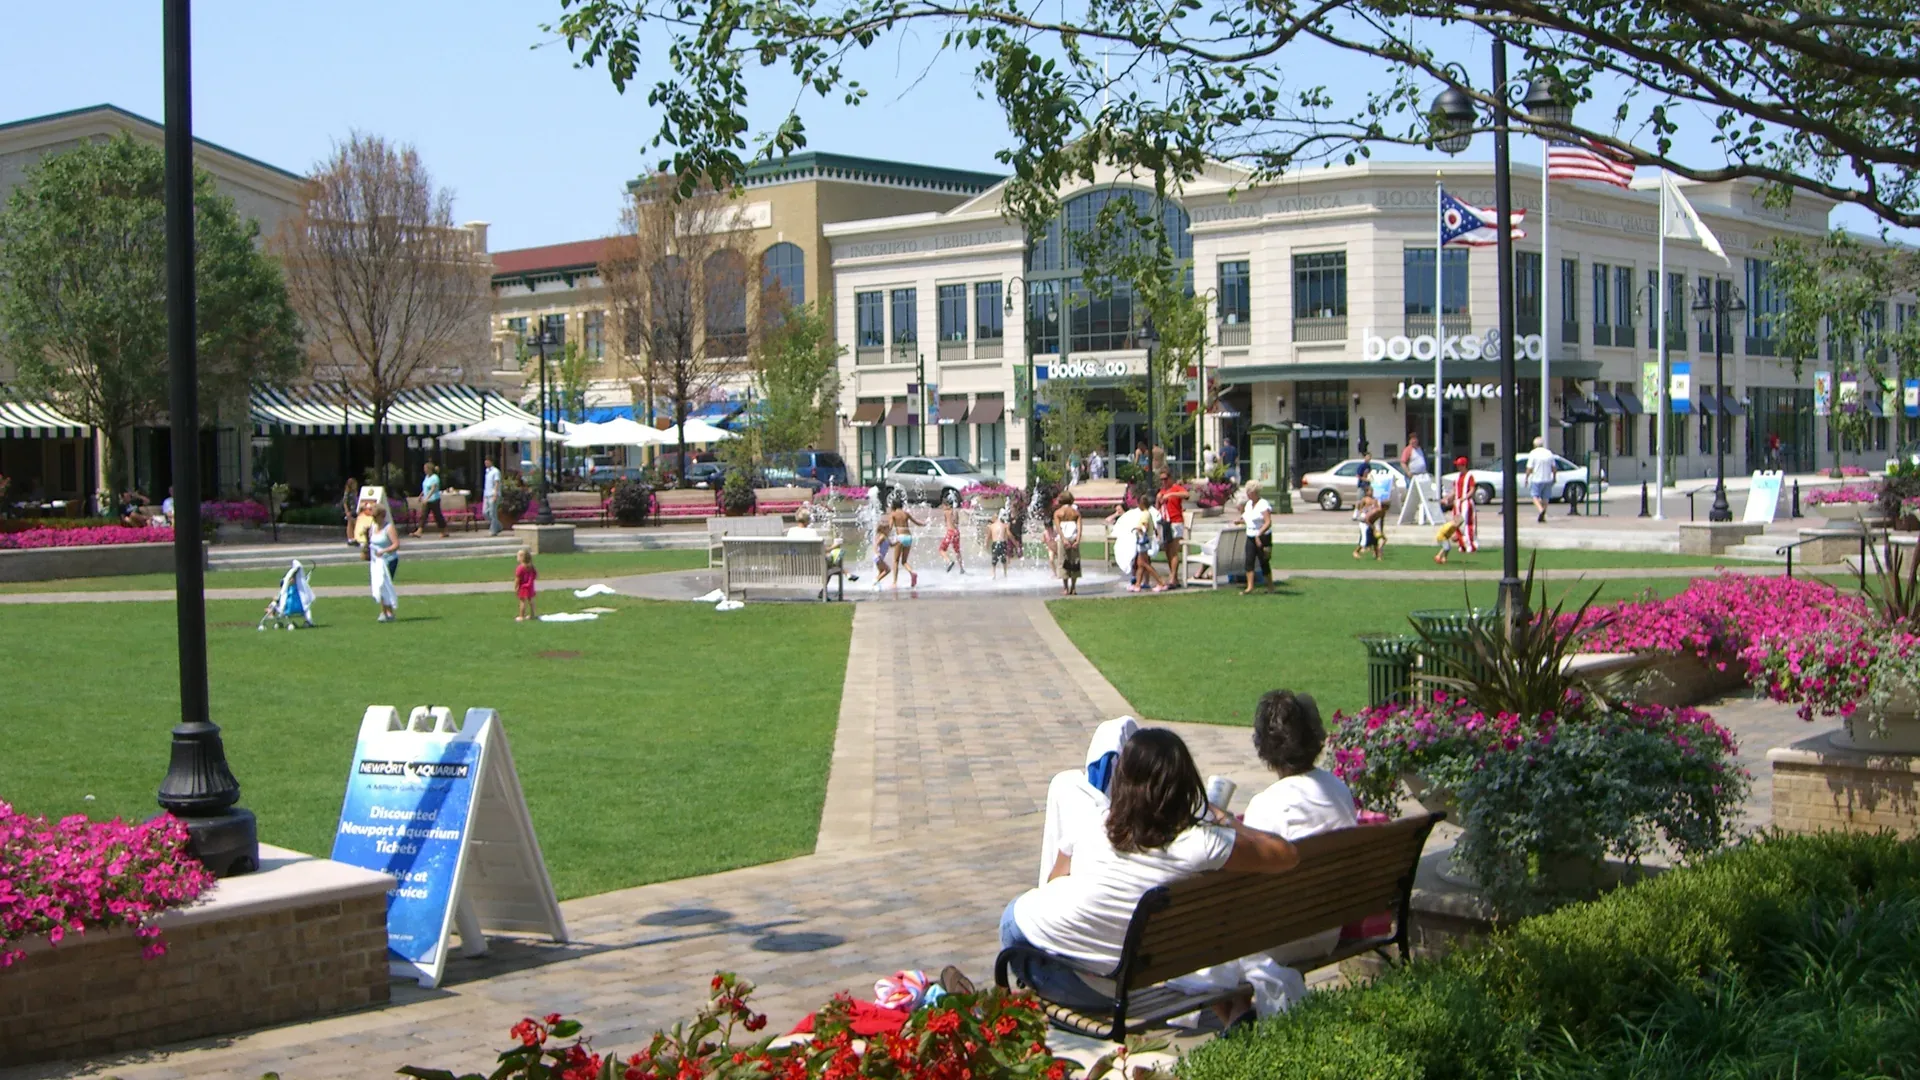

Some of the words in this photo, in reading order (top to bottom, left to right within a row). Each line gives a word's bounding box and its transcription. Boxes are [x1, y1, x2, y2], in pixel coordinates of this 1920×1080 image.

[1397, 382, 1437, 400] JOE
[1444, 382, 1519, 400] MUG
[360, 761, 404, 774] NEWPORT
[416, 764, 468, 777] AQUARIUM
[369, 805, 437, 821] Discounted
[341, 821, 395, 837] Newport
[396, 824, 460, 840] Aquarium
[376, 840, 418, 854] Tickets
[413, 871, 428, 882] at
